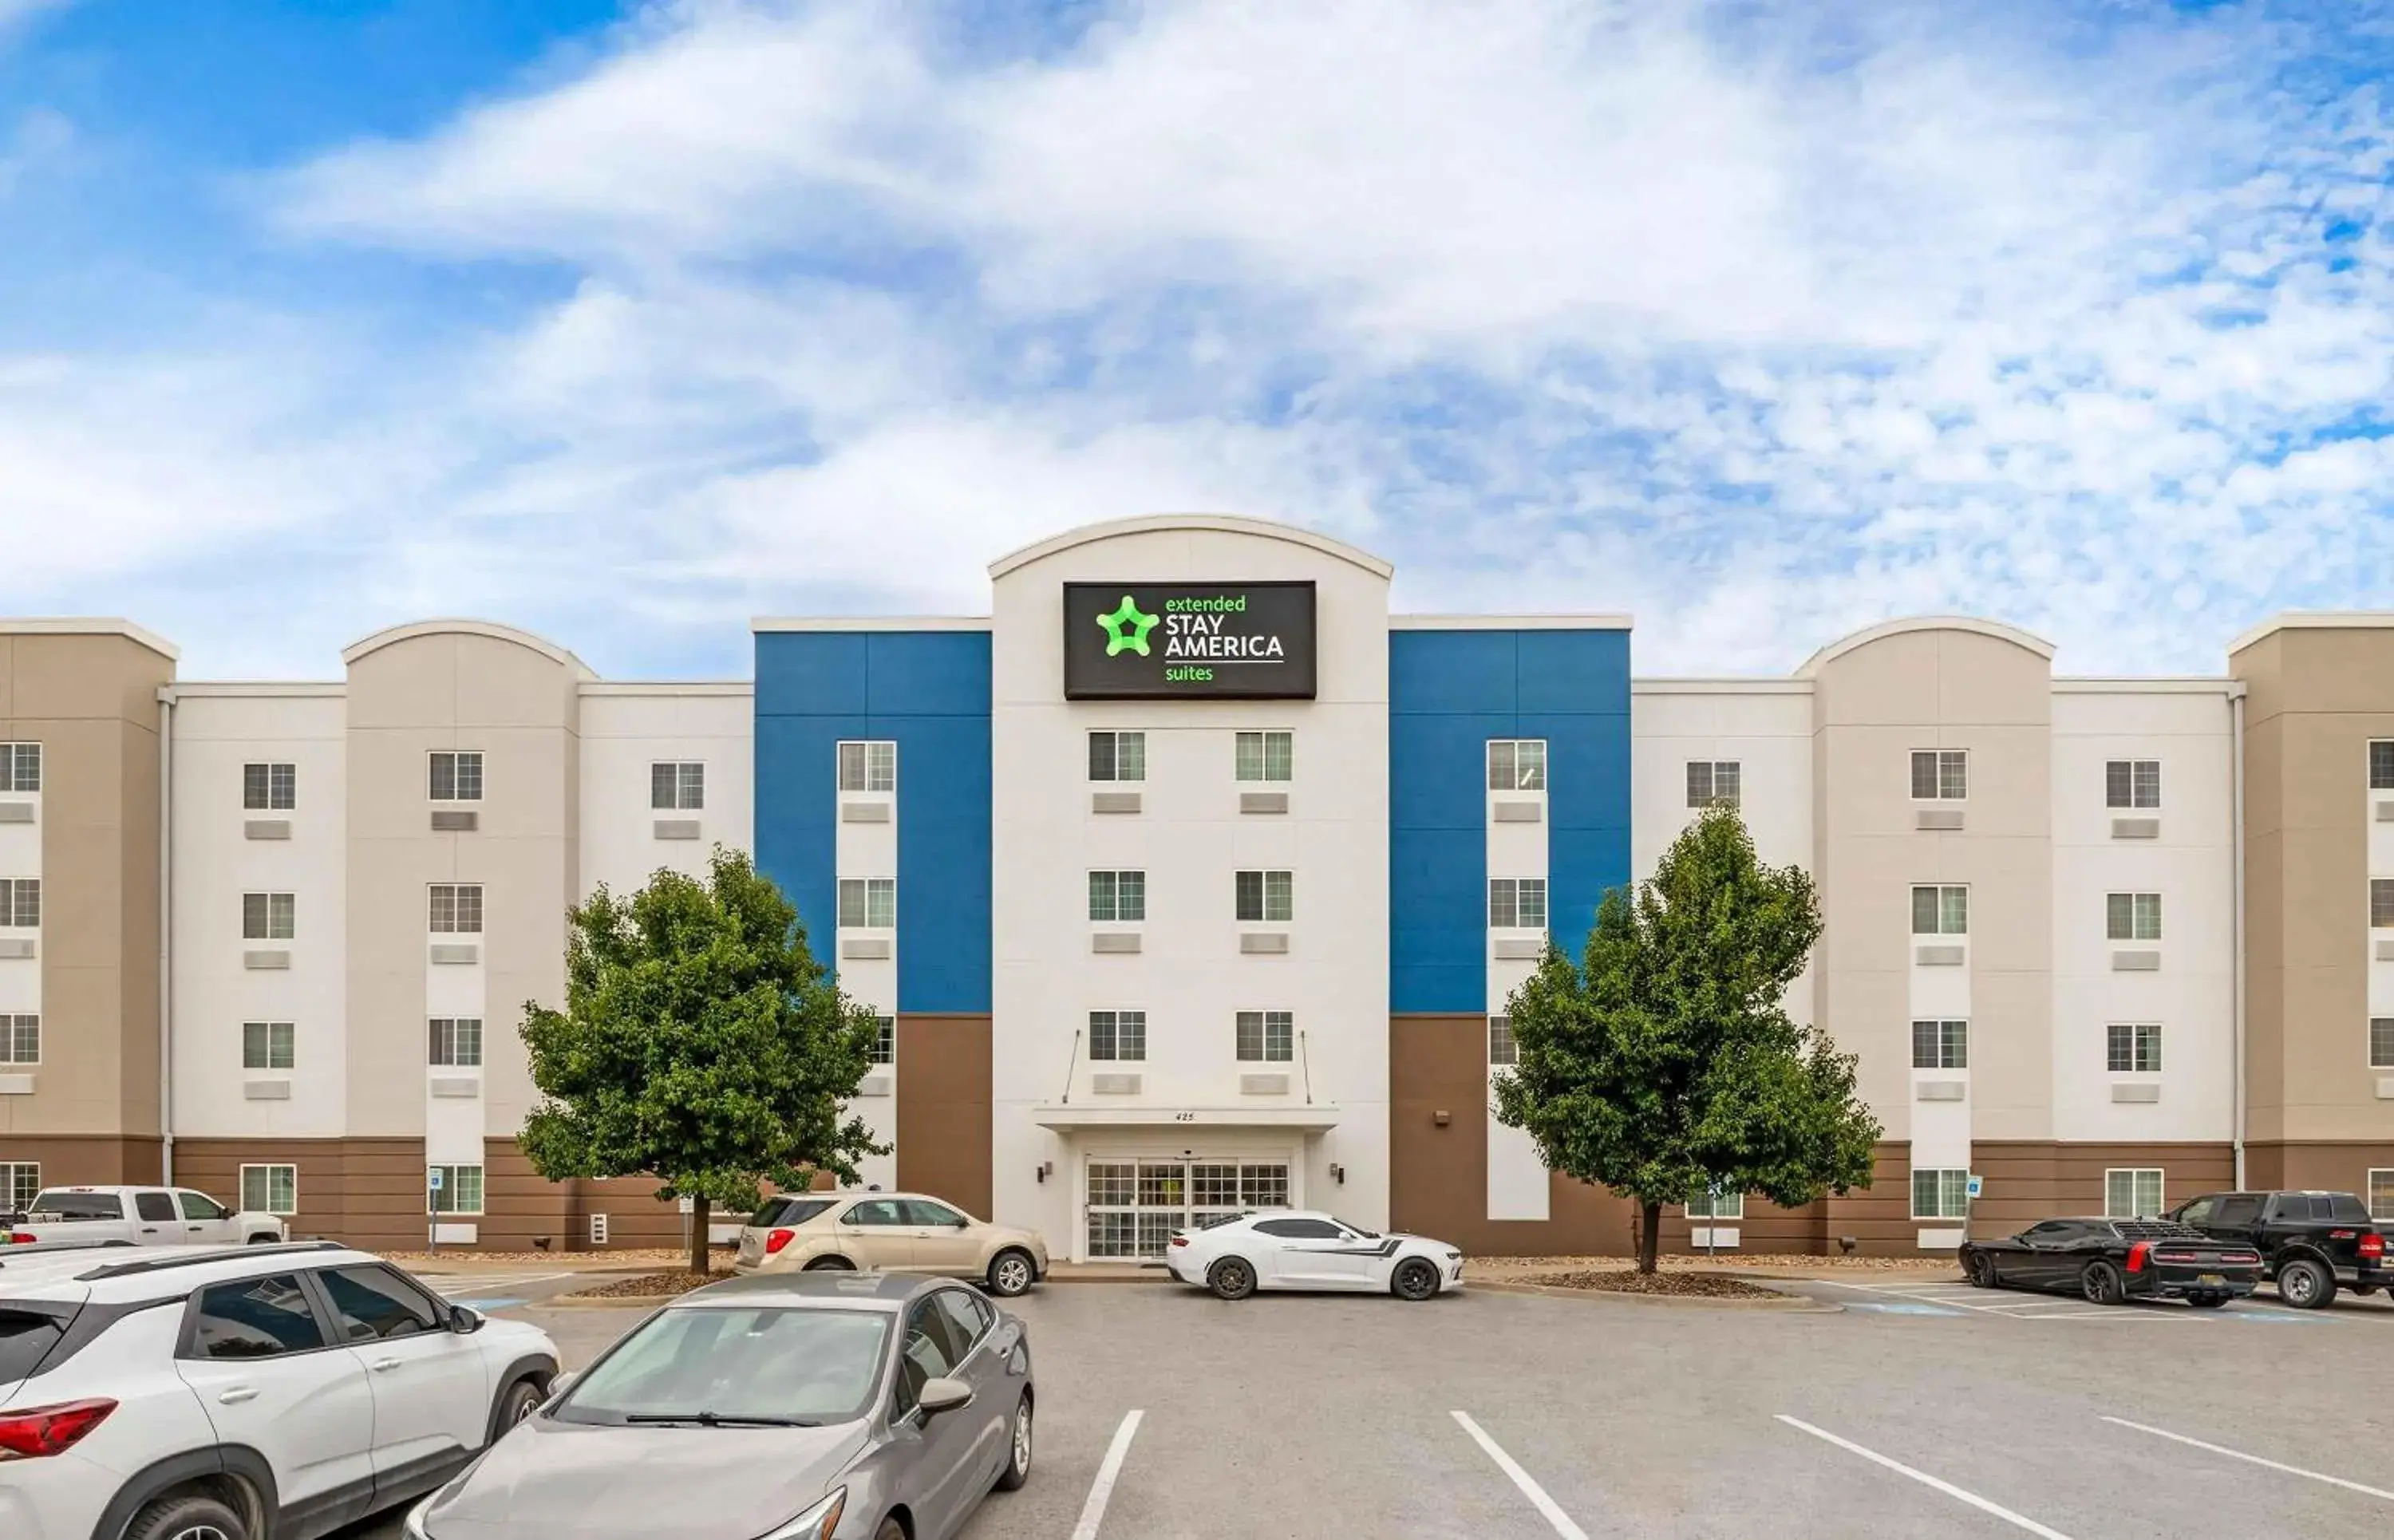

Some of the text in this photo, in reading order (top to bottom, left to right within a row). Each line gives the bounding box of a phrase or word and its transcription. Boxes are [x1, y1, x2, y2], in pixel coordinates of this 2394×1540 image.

[1166, 595, 1245, 611] extended
[1166, 614, 1224, 634] STAY
[1165, 636, 1283, 656] AMERICA
[1166, 665, 1213, 681] suites
